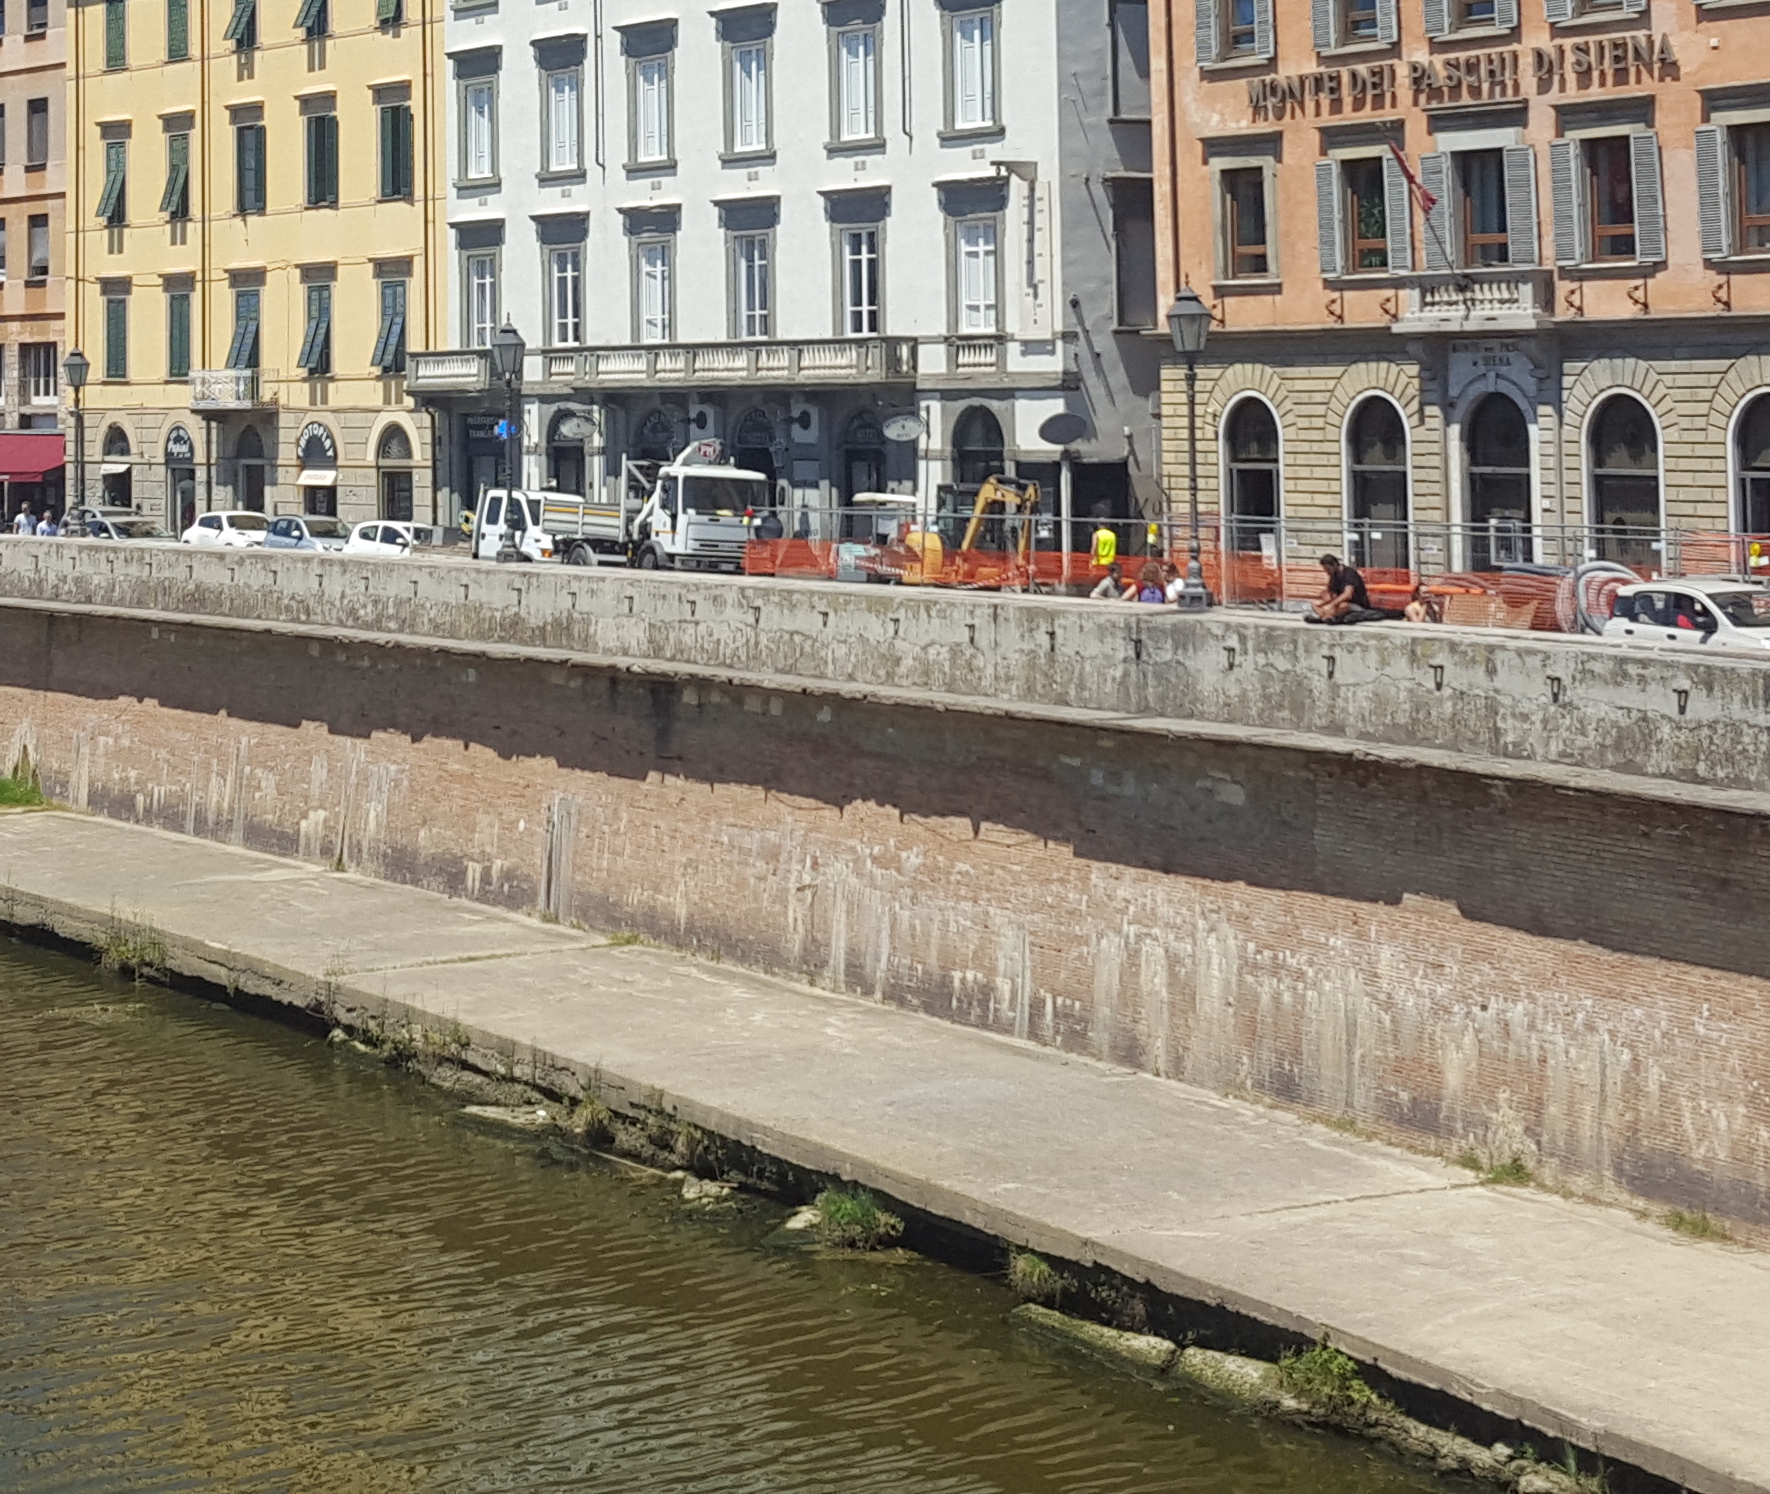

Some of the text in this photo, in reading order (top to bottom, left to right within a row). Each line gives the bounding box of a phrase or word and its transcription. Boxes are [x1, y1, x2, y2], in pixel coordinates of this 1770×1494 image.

[1246, 32, 1678, 106] MONTE DEI PASCHI DI SIENA
[297, 422, 335, 457] PHOTOPLAY
